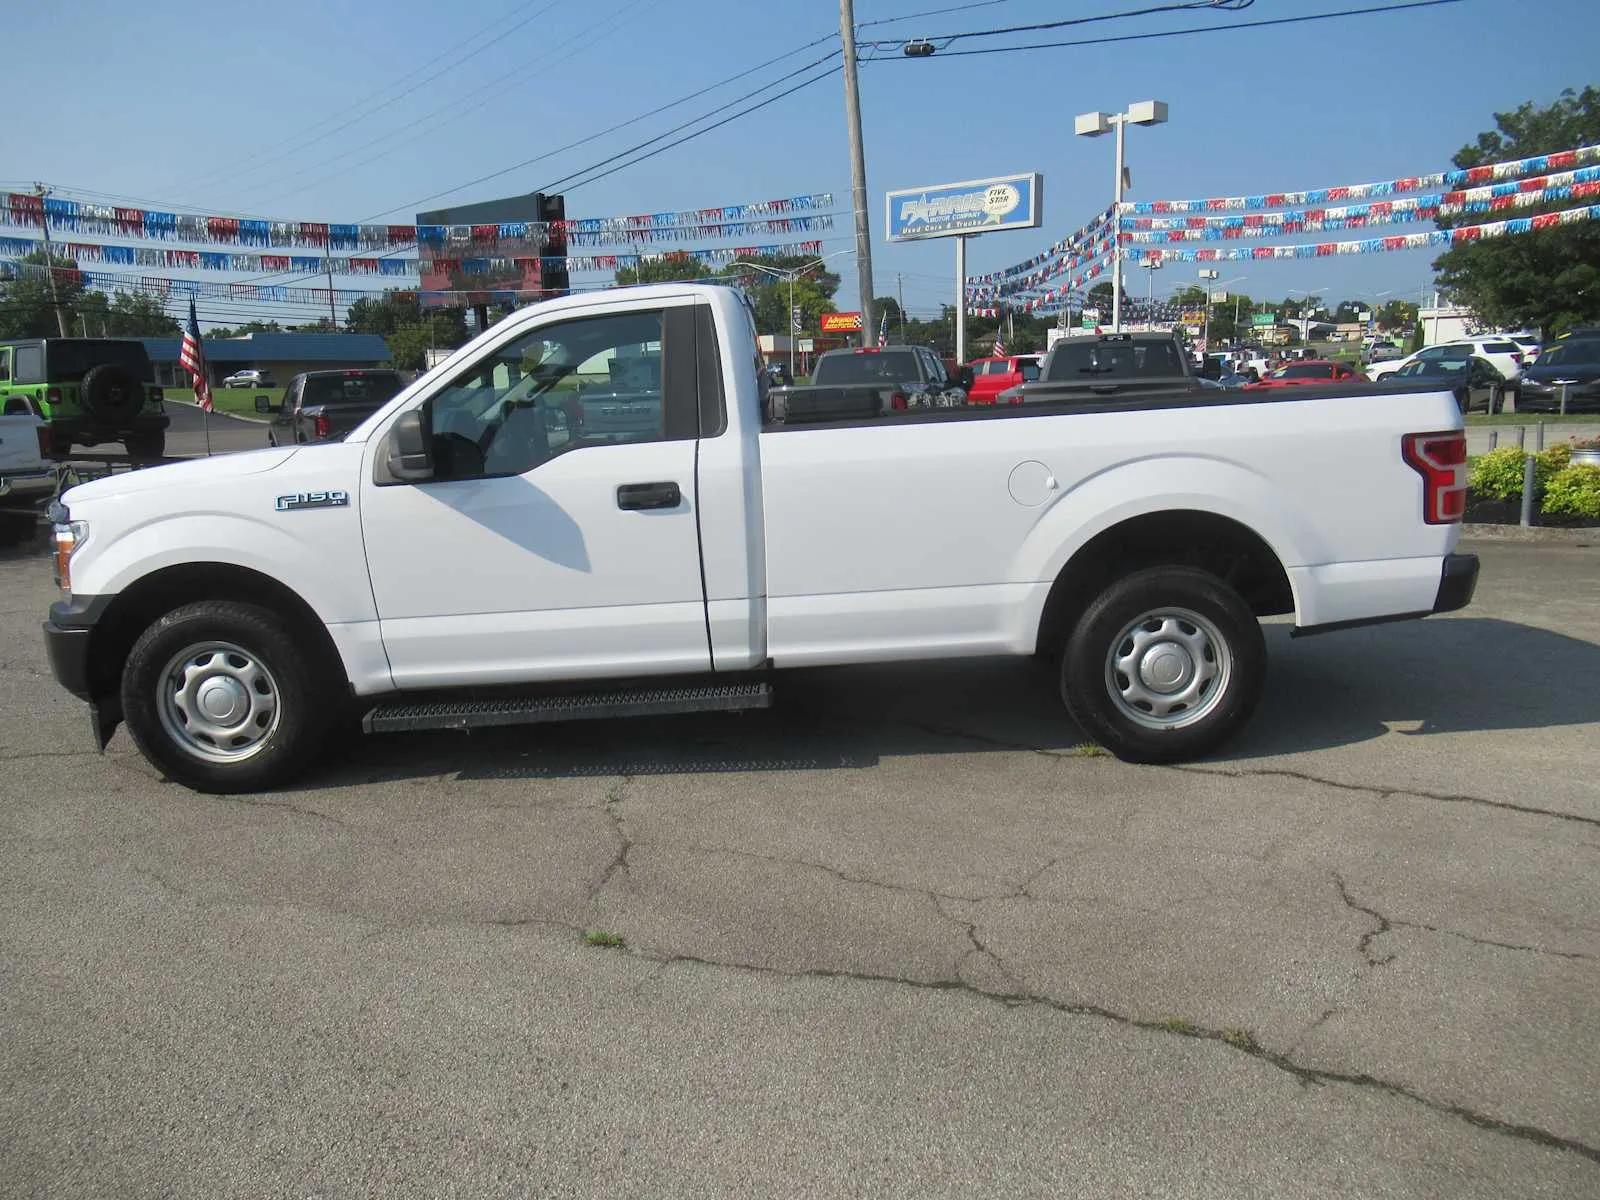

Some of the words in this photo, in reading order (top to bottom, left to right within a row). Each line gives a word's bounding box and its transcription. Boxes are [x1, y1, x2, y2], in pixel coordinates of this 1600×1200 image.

[989, 189, 1007, 197] FIVE
[989, 196, 1009, 204] STAR
[929, 215, 951, 224] MOTOR
[952, 212, 980, 221] COMPANY
[902, 226, 922, 235] Used
[924, 224, 942, 232] Cars
[956, 220, 981, 228] Trucks
